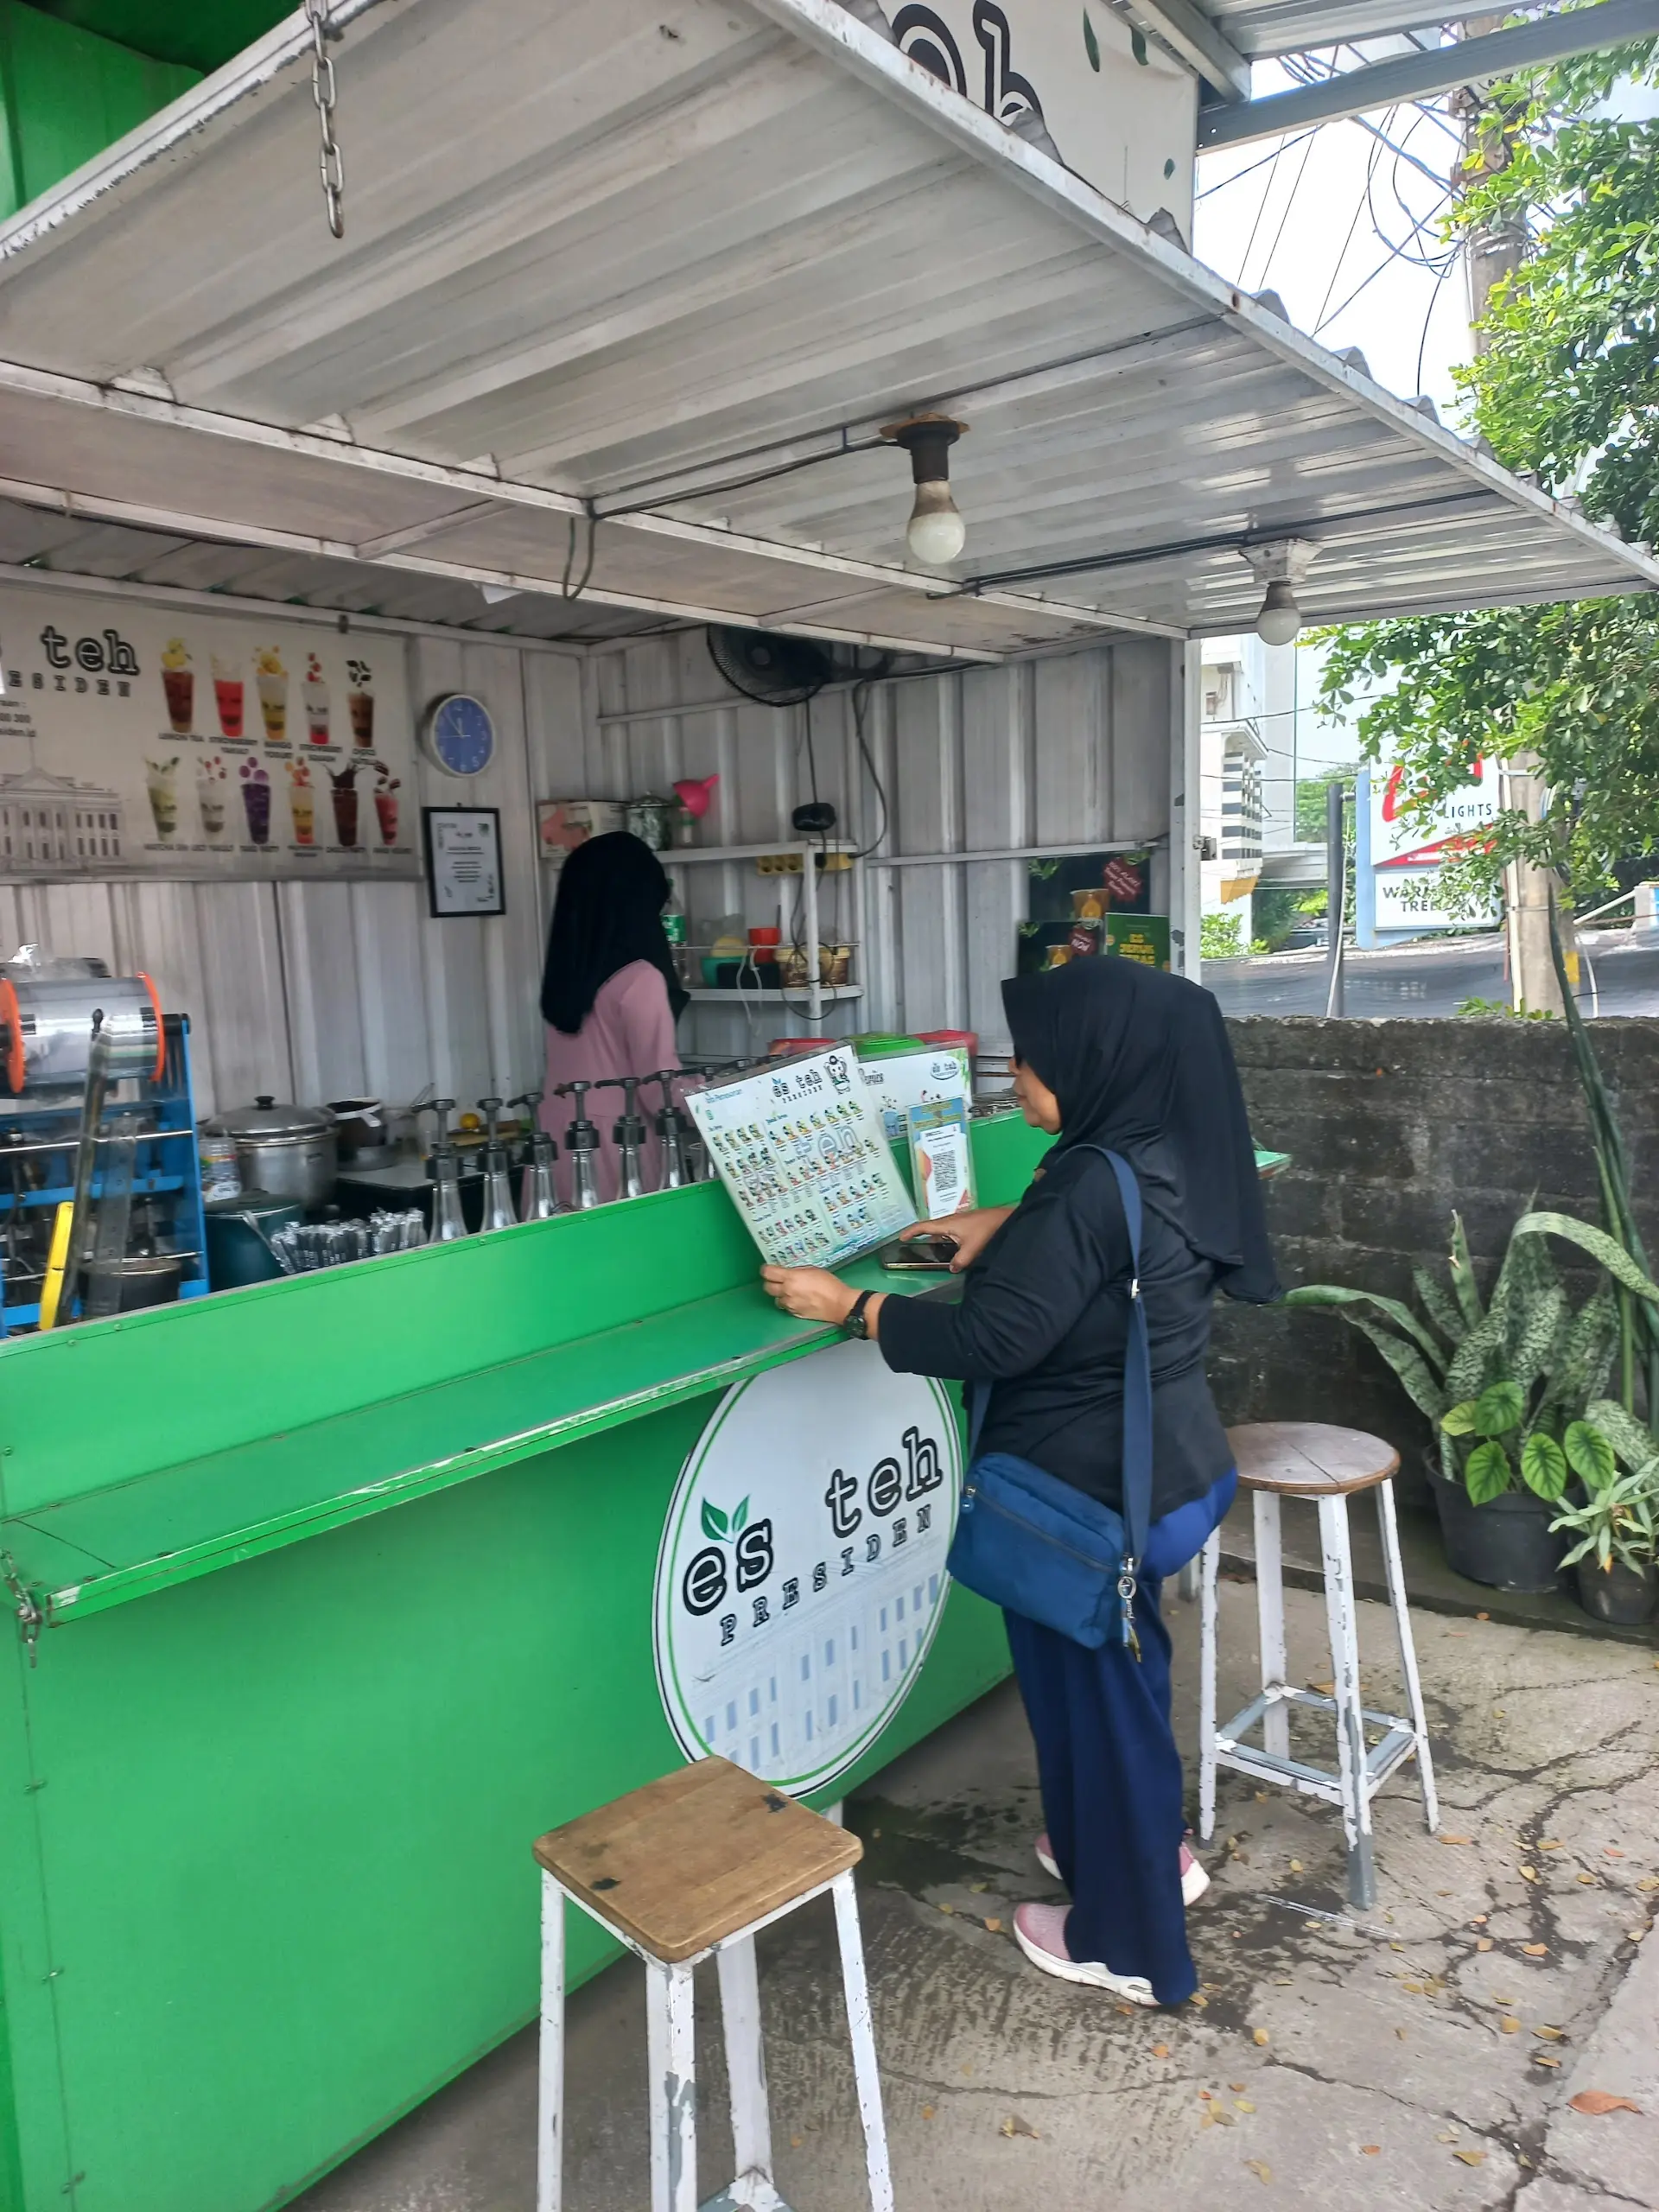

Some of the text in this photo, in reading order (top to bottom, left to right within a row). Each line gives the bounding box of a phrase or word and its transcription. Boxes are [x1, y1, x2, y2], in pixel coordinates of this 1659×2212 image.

[40, 626, 140, 676] teh
[772, 1069, 823, 1097] es teh
[683, 1426, 943, 1616] es teh
[720, 1503, 932, 1646] PRESIDEN
